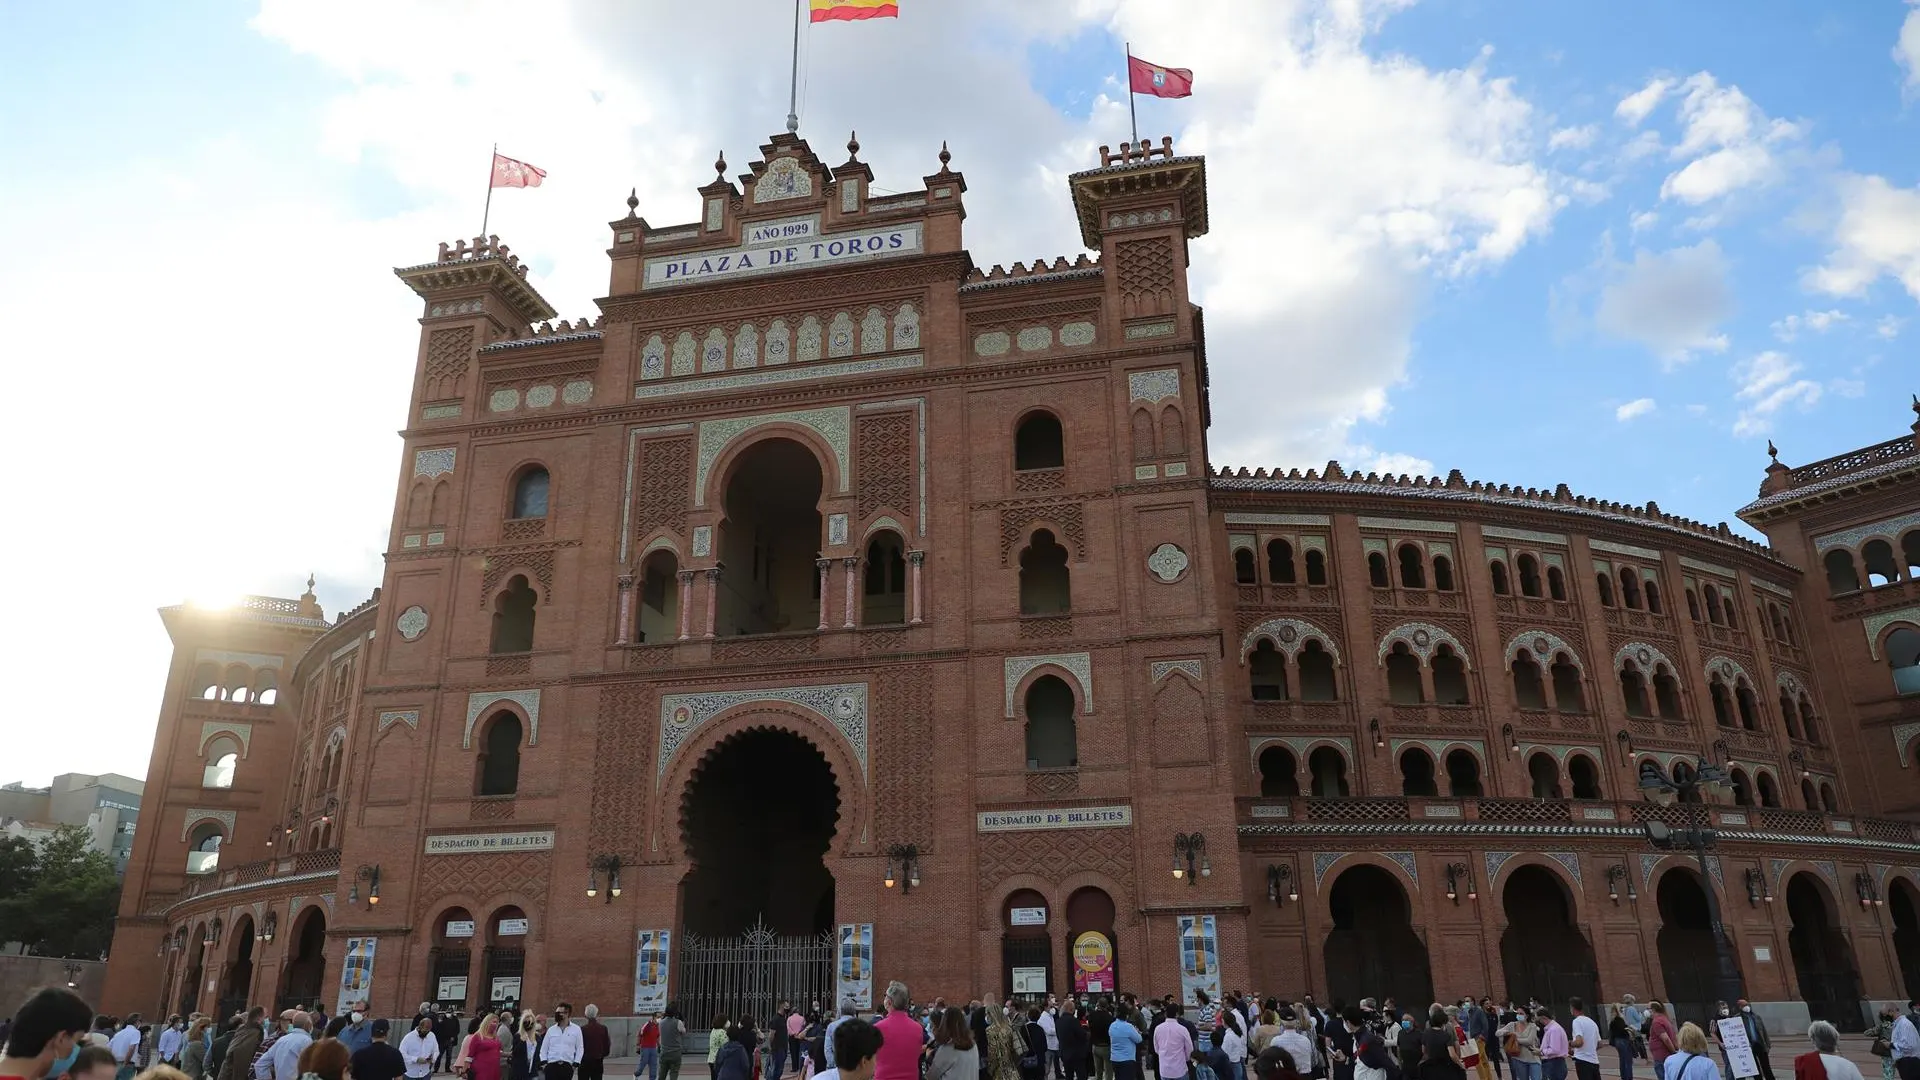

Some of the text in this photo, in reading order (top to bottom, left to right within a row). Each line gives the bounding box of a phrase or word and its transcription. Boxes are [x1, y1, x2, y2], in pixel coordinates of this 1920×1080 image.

[752, 223, 809, 241] AÑO 1929
[665, 233, 903, 279] PLAZA DE TOROS
[985, 811, 1124, 826] DESPACHO DE BILLETES
[431, 836, 548, 849] DESPACHO DE BILLETES
